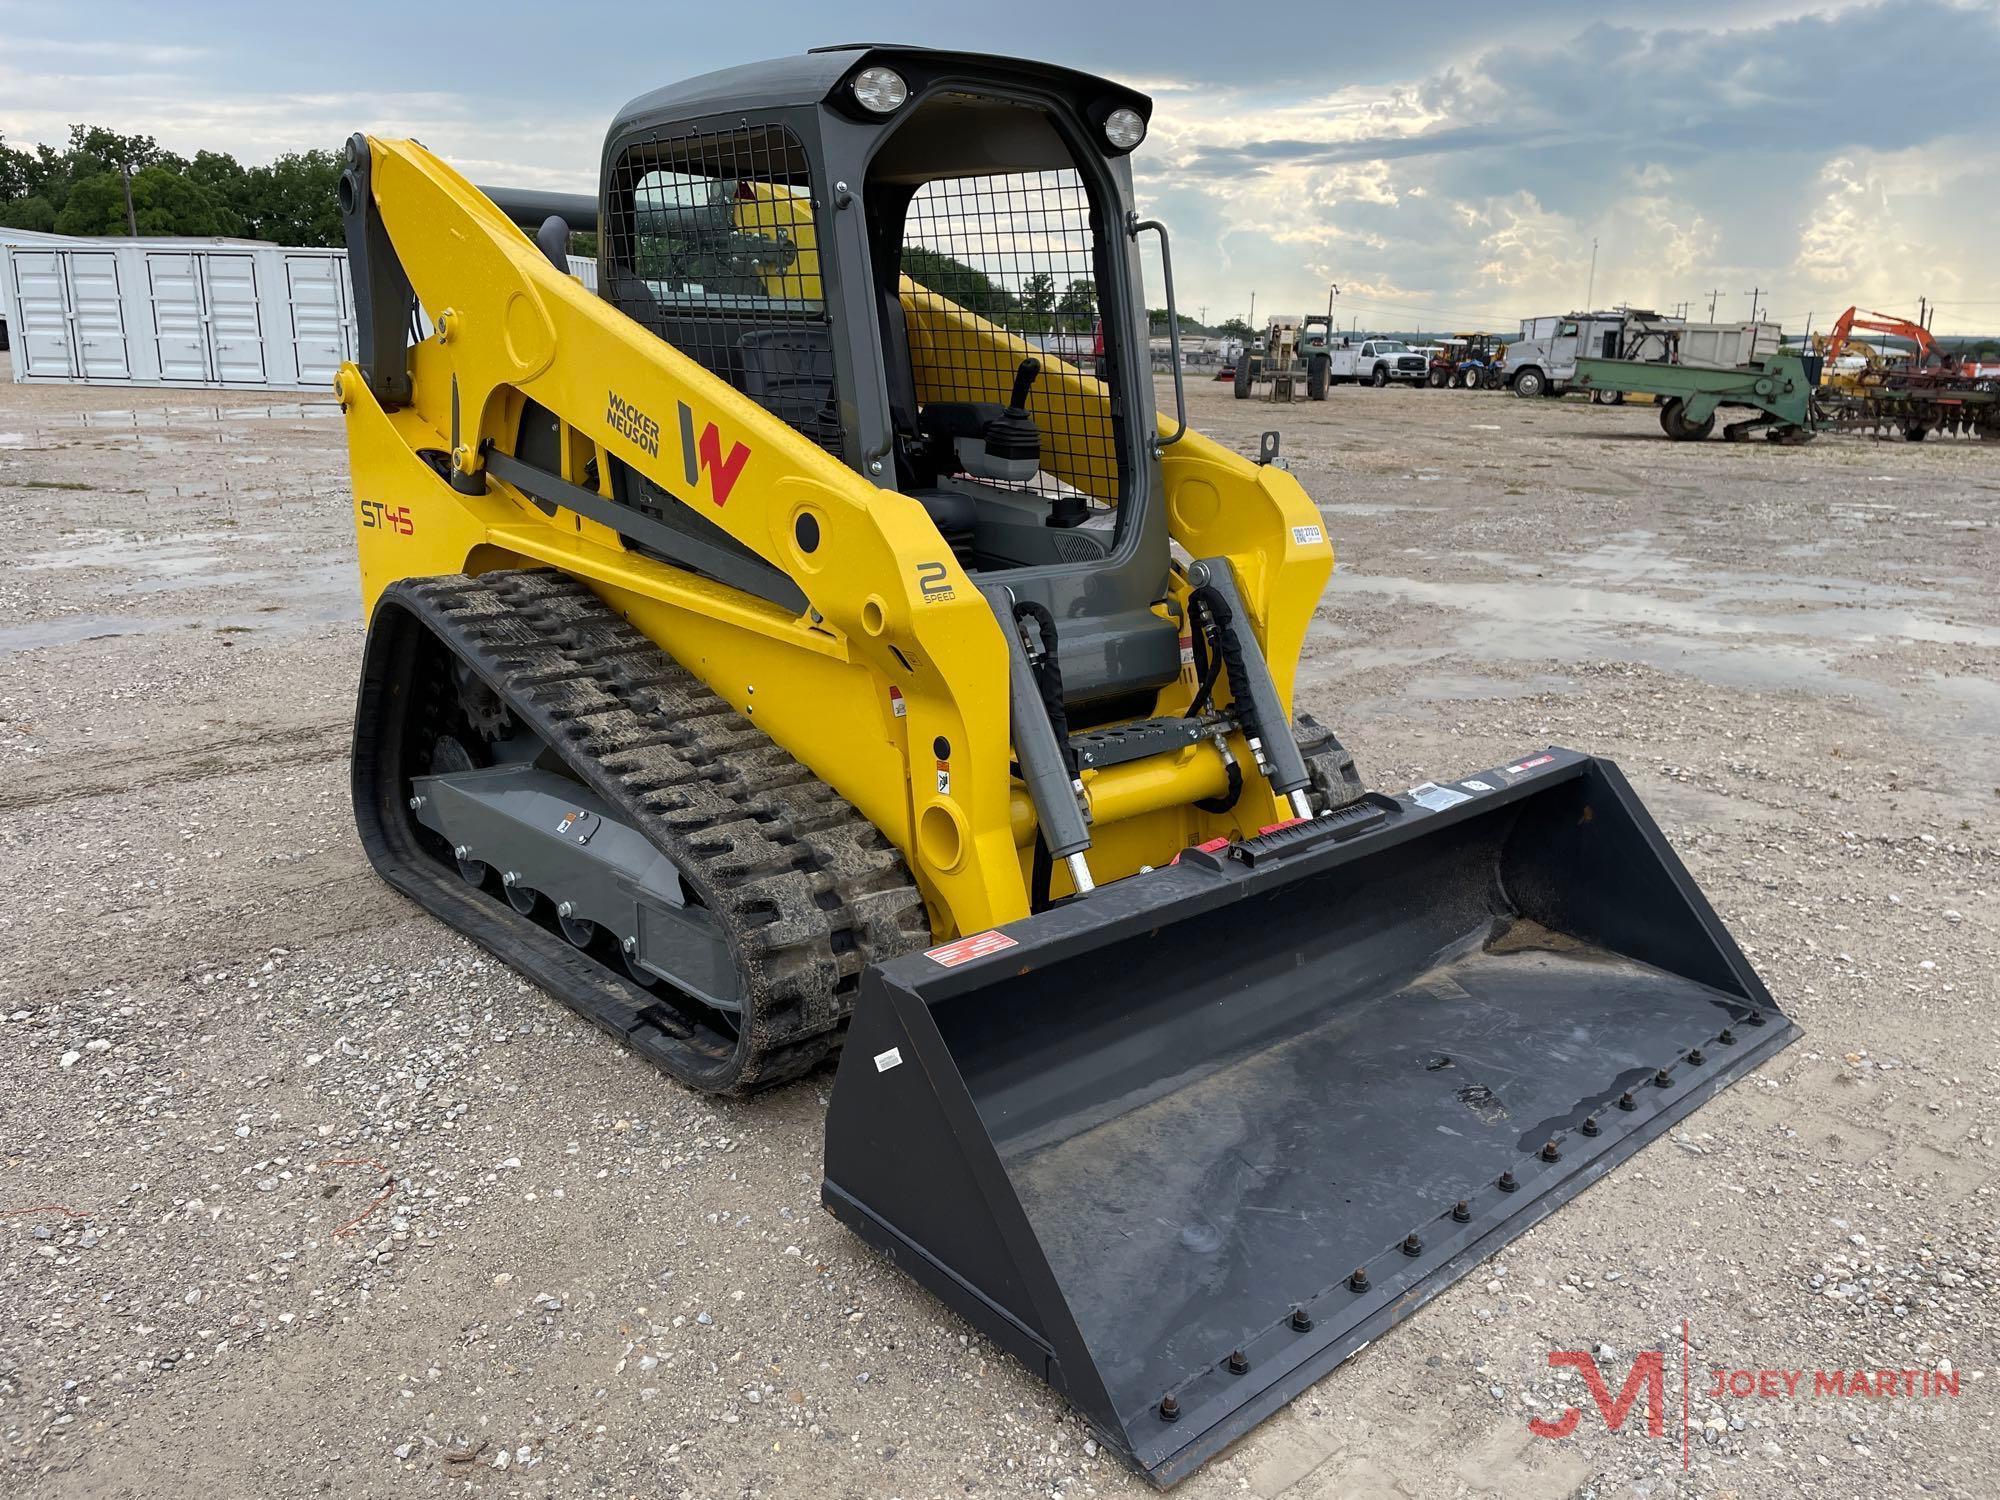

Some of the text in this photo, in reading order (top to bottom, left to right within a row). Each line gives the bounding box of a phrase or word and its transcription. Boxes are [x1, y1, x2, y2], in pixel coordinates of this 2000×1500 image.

[606, 408, 659, 460] NEUSON
[608, 390, 660, 442] WACKER
[361, 500, 414, 536] ST45
[916, 561, 953, 595] 2
[923, 591, 956, 604] SPEED
